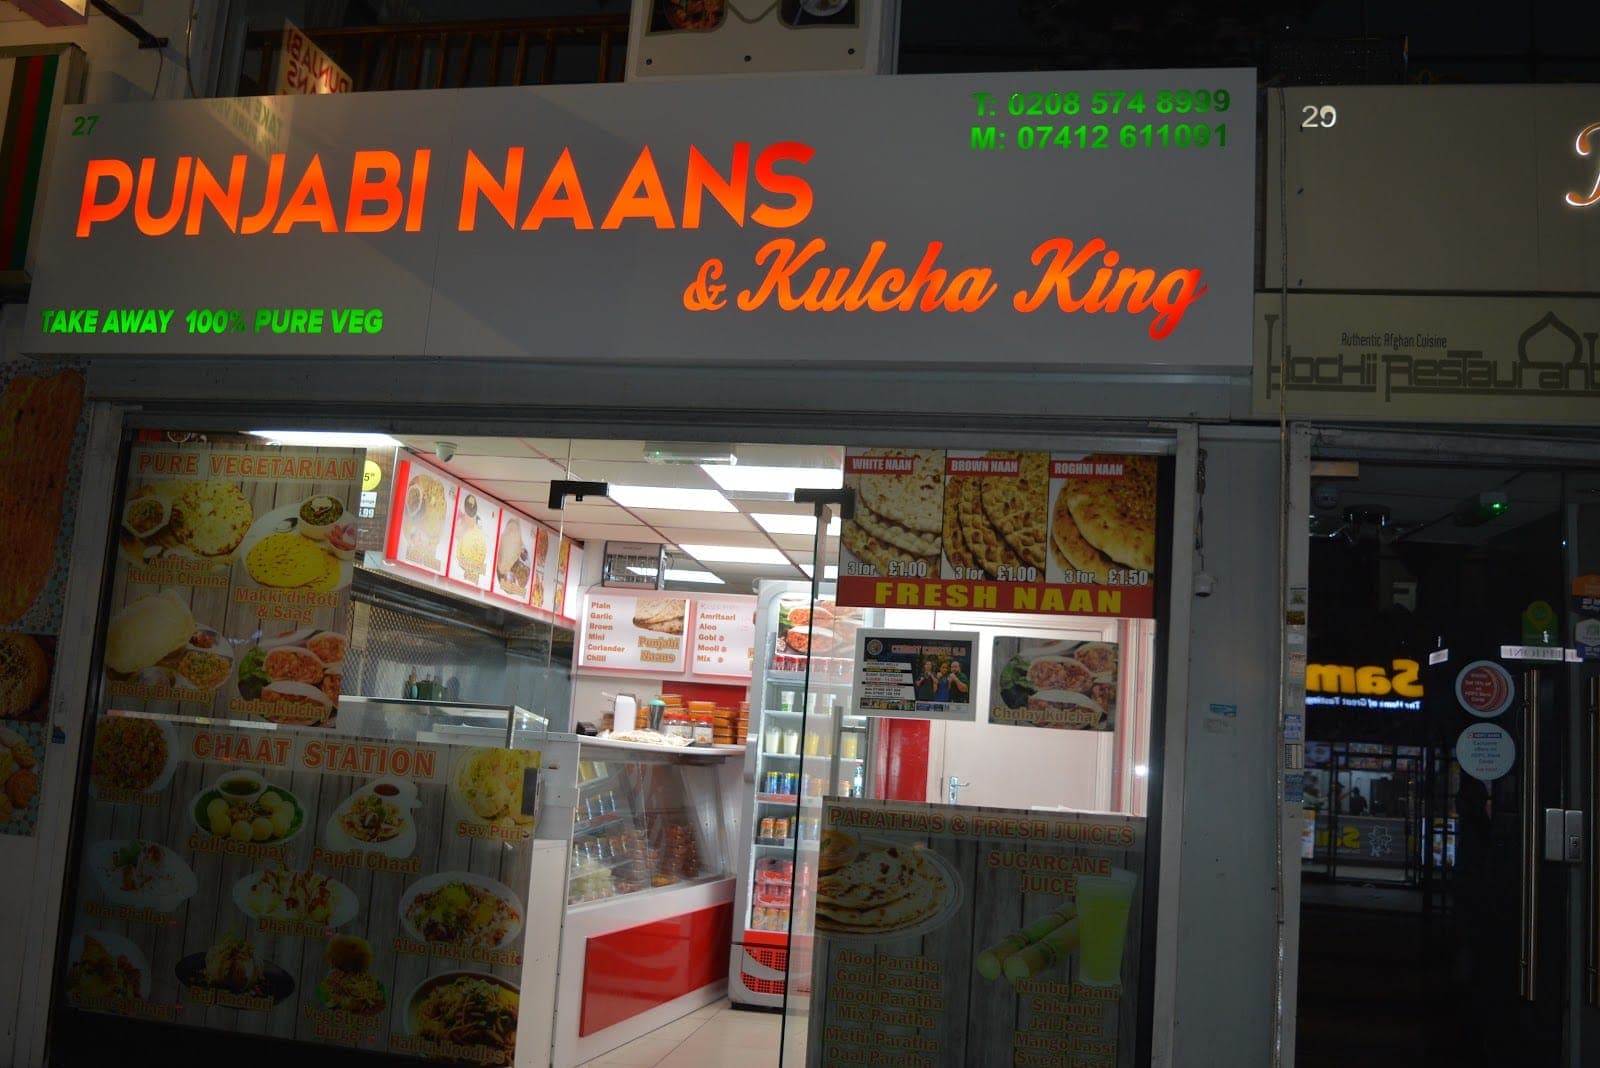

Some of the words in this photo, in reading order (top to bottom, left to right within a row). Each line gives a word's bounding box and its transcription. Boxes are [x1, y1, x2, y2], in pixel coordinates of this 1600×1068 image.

[971, 91, 996, 116] T:
[1008, 91, 1080, 116] 0208
[1091, 90, 1146, 114] 574
[1156, 88, 1231, 114] 8999
[1301, 104, 1337, 129] 29
[72, 115, 99, 136] 27
[970, 126, 1006, 150] M:
[1018, 125, 1110, 149] 07412
[1119, 123, 1227, 148] 611091
[75, 148, 431, 237] PUNJABI
[458, 141, 816, 231] NAANS
[683, 258, 727, 312] &
[737, 238, 997, 313] Kulcha
[1013, 238, 1208, 341] King
[41, 309, 99, 333] TAKE
[101, 309, 175, 333] AWAY
[185, 309, 247, 333] 100%
[254, 309, 325, 333] PURE
[331, 309, 384, 333] VEG
[1416, 333, 1447, 349] Cuisine
[139, 453, 198, 474] PURE
[210, 455, 357, 479] VEGETARIAN
[852, 458, 884, 470] WHITE
[885, 459, 913, 471] NAAN
[951, 460, 989, 472] BROWN
[990, 461, 1018, 473] NAAN
[1054, 462, 1093, 475] ROGHNI
[1095, 463, 1123, 476] NAAN
[848, 561, 857, 575] 3
[888, 560, 927, 577] £1.00
[954, 567, 963, 580] 3
[966, 567, 984, 581] for
[997, 565, 1037, 582] £1.00
[1065, 570, 1073, 583] 3
[1076, 570, 1095, 583] for
[1108, 569, 1149, 586] £1.50
[591, 601, 612, 610] Plain
[875, 582, 997, 609] FRESH
[1013, 586, 1122, 614] NAAN
[273, 606, 313, 624] Saag
[590, 612, 613, 621] Garlic
[700, 612, 736, 622] Amritsari
[589, 623, 613, 631] Brown
[700, 623, 717, 632] Aloo
[588, 633, 605, 641] Mini
[698, 633, 717, 642] Gobi
[587, 643, 626, 653] Coriander
[697, 655, 711, 663] Mix
[992, 706, 1044, 723] Cholay
[193, 732, 292, 766] CHAAT
[303, 741, 436, 778] STATION
[457, 822, 488, 839] Sev
[828, 806, 945, 832] PARATHAS
[951, 815, 967, 834] &
[972, 814, 1048, 838] FRESH
[1052, 819, 1135, 845] JUICES
[366, 853, 420, 874] Chaat
[988, 850, 1111, 875] SUGARCANE
[1021, 875, 1074, 895] JUICE
[837, 949, 873, 965] Aloo
[878, 954, 941, 972] Paratha
